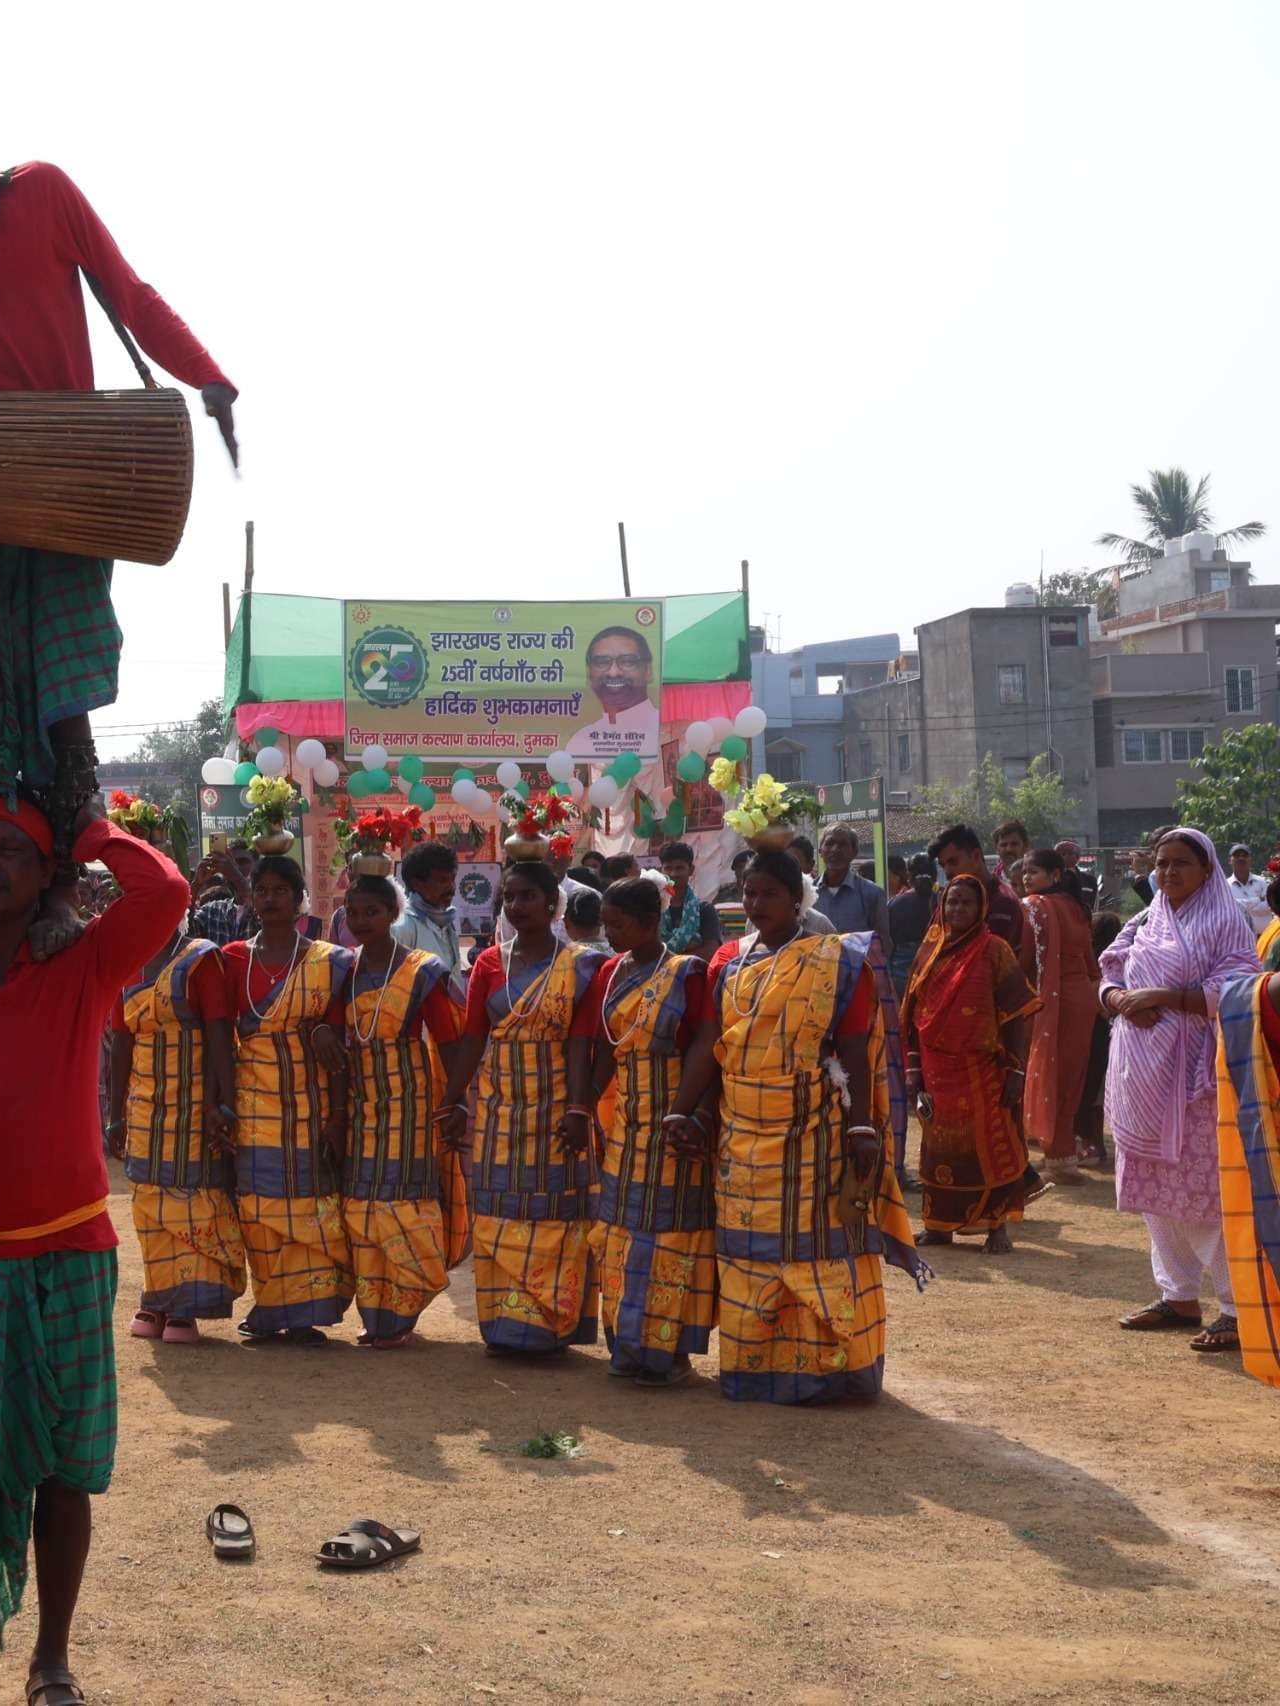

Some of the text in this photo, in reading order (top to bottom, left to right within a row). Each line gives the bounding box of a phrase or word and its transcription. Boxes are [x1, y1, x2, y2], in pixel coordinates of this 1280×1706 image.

[430, 625, 575, 652] झारखण्ड राज्य की
[441, 658, 565, 683] 25वीं वर्षगाँठ की
[424, 691, 478, 717] हार्दिक
[483, 692, 583, 725] शुभकामनाएँ
[349, 727, 380, 746] जिला
[382, 731, 419, 746] समाज
[421, 731, 464, 746] कल्याण
[523, 731, 560, 753] दुमका
